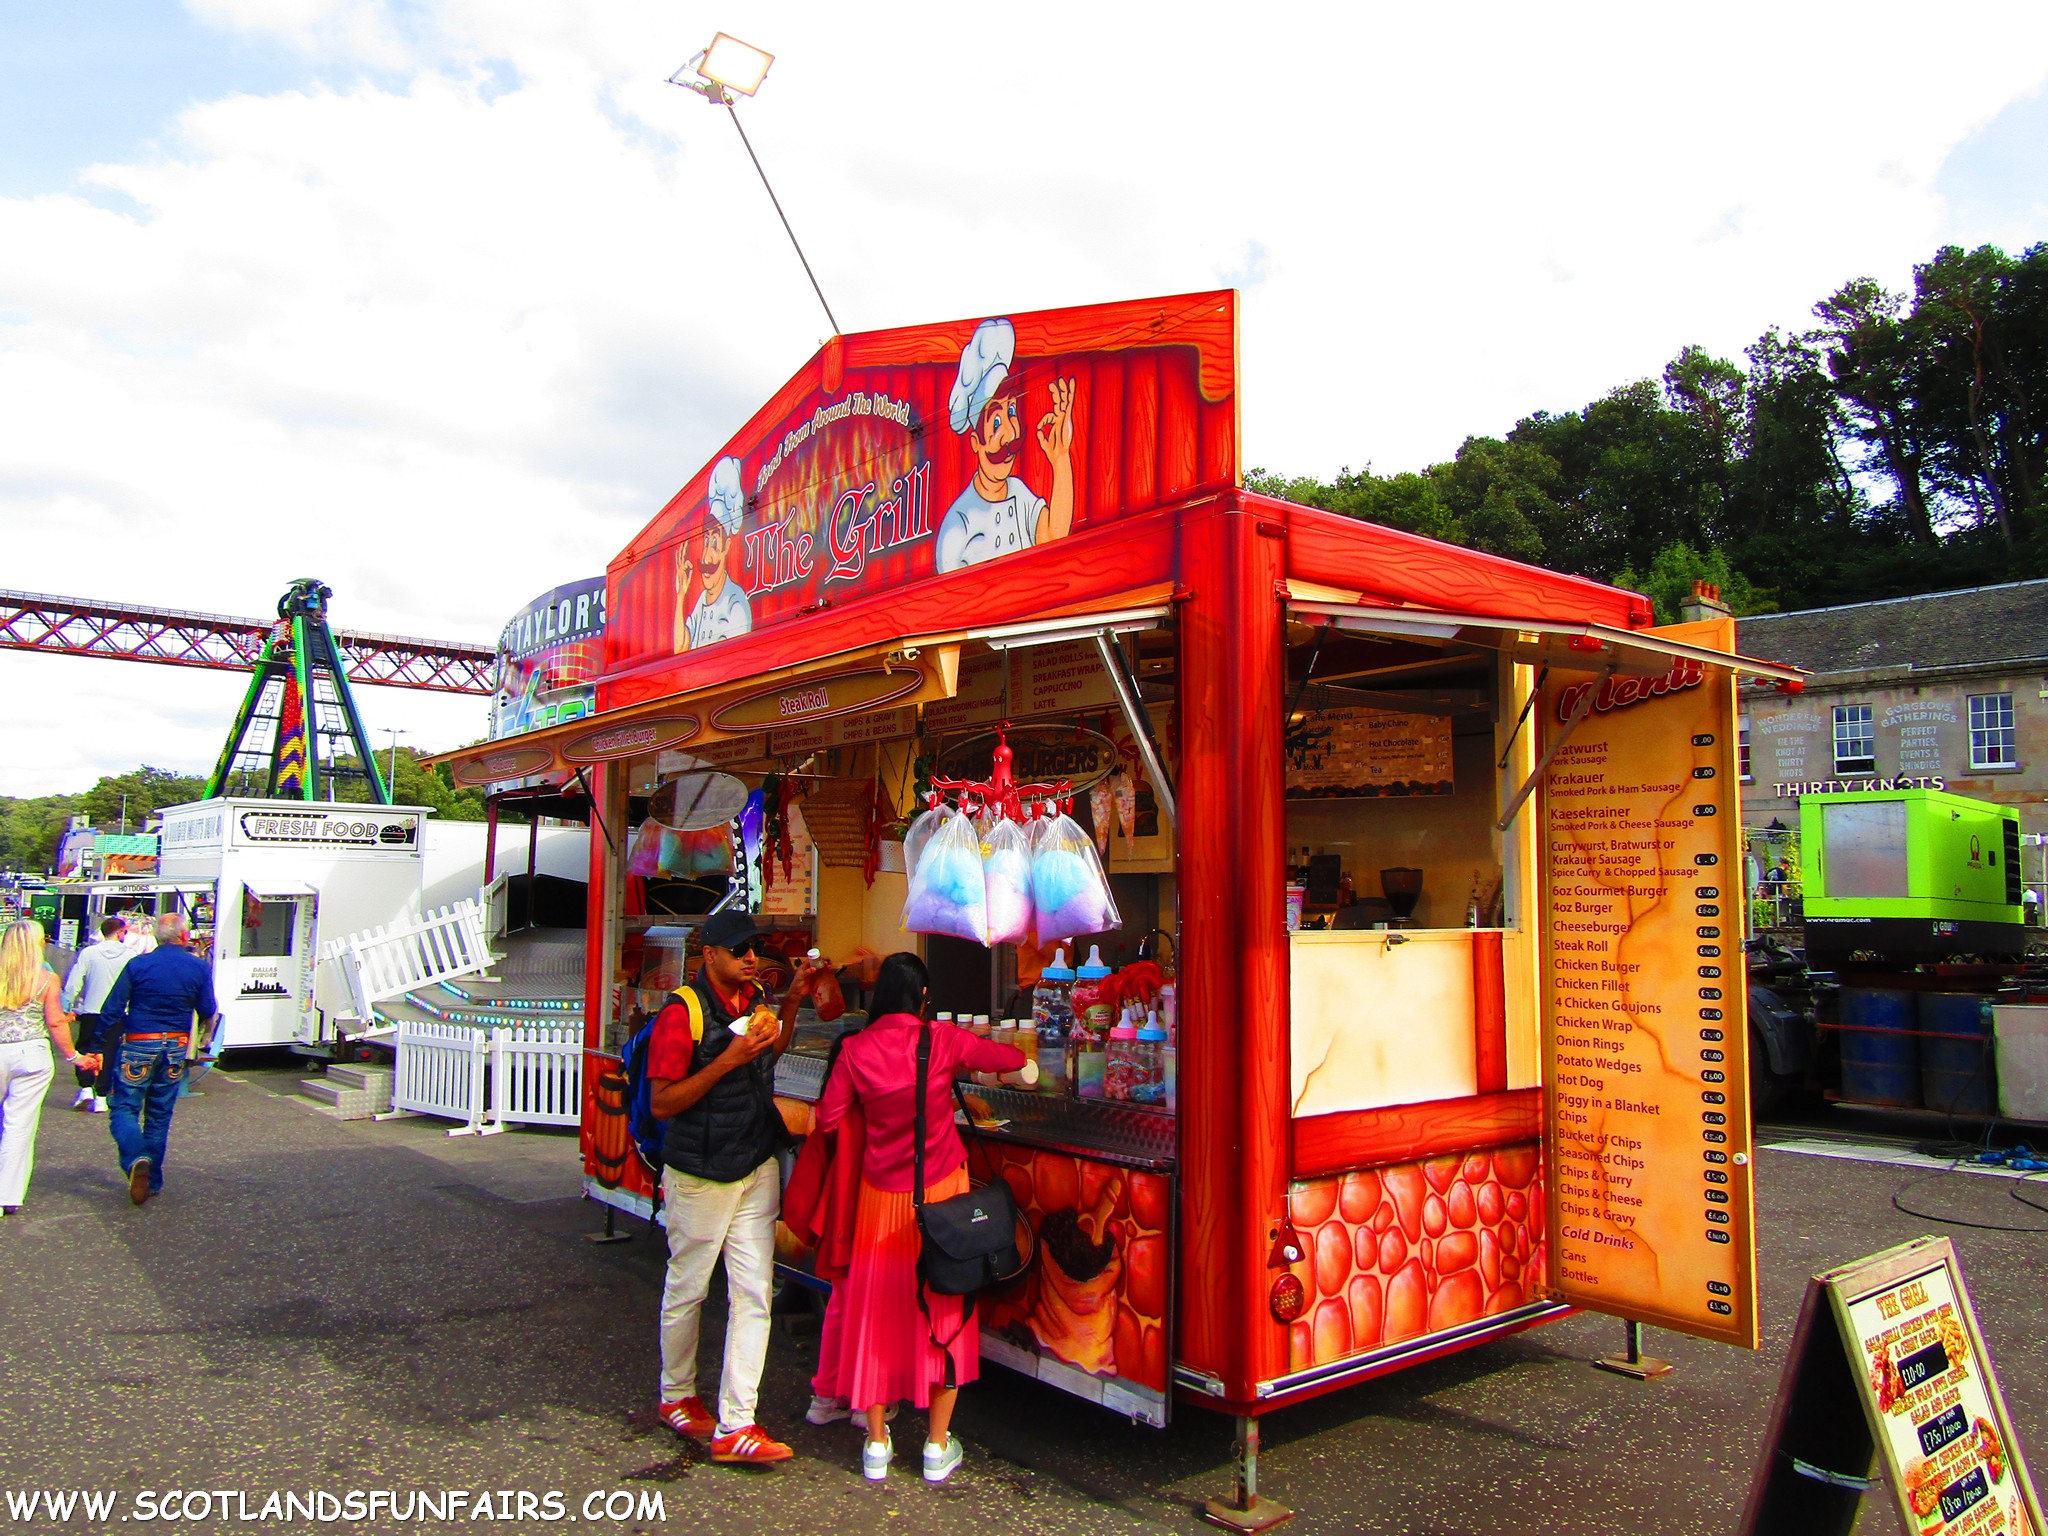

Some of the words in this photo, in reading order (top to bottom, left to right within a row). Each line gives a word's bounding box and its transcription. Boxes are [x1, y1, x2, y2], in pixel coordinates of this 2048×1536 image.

[757, 444, 782, 492] Food
[784, 422, 809, 458] From
[812, 394, 851, 435] Around
[852, 393, 871, 415] The
[874, 393, 910, 426] World
[745, 507, 813, 599] The
[825, 461, 932, 584] Grill
[1033, 657, 1057, 669] SALAD
[1060, 652, 1083, 664] ROLLS
[1033, 669, 1075, 682] BREAKFAST
[1034, 681, 1082, 696] CAPPUCCINO
[780, 693, 807, 715] Steak
[808, 687, 829, 708] Roll
[1034, 699, 1055, 709] LATTE
[1885, 702, 1951, 716] GORGEOUS
[844, 717, 863, 728] CHIPS
[866, 716, 870, 724] &
[873, 711, 896, 723] GRAVY
[1328, 713, 1352, 721] Menu
[1757, 713, 1821, 726] WONDERFUL
[1881, 713, 1958, 727] GATHERINGS
[773, 731, 791, 740] STEAK
[793, 728, 808, 737] ROLL
[844, 729, 863, 740] CHIPS
[873, 724, 896, 735] BEANS
[1761, 723, 1818, 735] WEDDINGS
[1901, 726, 1936, 736] PERFECT
[592, 734, 615, 752] Chicken
[633, 728, 656, 747] Burger
[773, 742, 792, 751] BAKED
[793, 736, 823, 749] POTATOES
[1384, 739, 1419, 747] Chocolate
[1775, 748, 1794, 757] KNOT
[1900, 749, 1931, 759] EVENTS
[1934, 749, 1939, 757] &
[1571, 755, 1607, 765] Sausage
[1900, 760, 1940, 770] SHINDIGS
[1551, 773, 1604, 785] Krakauer
[1778, 768, 1803, 777] KNOTS
[1551, 787, 1584, 797] Smoked
[1587, 786, 1607, 795] Pork
[1609, 786, 1615, 794] &
[1618, 785, 1638, 793] Ham
[1642, 783, 1680, 793] Sausage
[1773, 779, 1854, 797] THIRTY
[1863, 776, 1945, 791] KNOTS
[1551, 807, 1630, 819] Kaesekrainer
[254, 819, 317, 836] FRESH
[322, 823, 378, 837] FOOD
[1551, 822, 1585, 831] Smoked
[1589, 821, 1607, 830] Pork
[1610, 821, 1616, 829] &
[1619, 820, 1651, 828] Cheese
[1654, 819, 1694, 829] Sausage
[1552, 840, 1608, 853] Currywurst,
[1611, 840, 1661, 850] Bratwurst
[1664, 840, 1675, 849] or
[1552, 854, 1596, 865] Krakauer
[1600, 854, 1641, 866] Sausage
[1552, 869, 1575, 878] Spice
[1577, 868, 1600, 878] Curry
[1605, 868, 1611, 876] &
[1614, 867, 1655, 878] Chopped
[1659, 867, 1698, 877] Sausage
[1553, 886, 1571, 895] 6oz
[1574, 886, 1624, 895] Gourmet
[1628, 886, 1667, 898] Burger
[1553, 903, 1572, 912] 4oz
[1575, 902, 1612, 915] Burger
[1554, 921, 1631, 935] Cheeseburger
[1554, 940, 1584, 950] Steak
[1587, 940, 1608, 951] Roll
[1554, 959, 1598, 970] Chicken
[1601, 961, 1640, 974] Burger
[1555, 978, 1598, 990] Chicken
[1602, 980, 1630, 992] Fillet
[1555, 998, 1562, 1006] 4
[1565, 998, 1608, 1010] Chicken
[1612, 1000, 1661, 1015] Goujons
[1556, 1016, 1599, 1028] Chicken
[1602, 1019, 1632, 1033] Wrap
[1556, 1035, 1590, 1047] Onion
[1593, 1038, 1624, 1053] Rings
[1557, 1054, 1592, 1067] Potato
[1595, 1057, 1642, 1073] Wedges
[1558, 1073, 1576, 1085] Hot
[1580, 1075, 1603, 1091] Dog
[1558, 1093, 1588, 1108] Piggy
[1592, 1097, 1602, 1108] in
[1606, 1101, 1611, 1109] a
[1615, 1099, 1660, 1115] Blanket
[1558, 1110, 1587, 1123] Chips
[1559, 1128, 1594, 1143] Bucket
[1597, 1133, 1608, 1144] of
[1611, 1135, 1642, 1149] Chips
[1559, 1146, 1610, 1163] Seasoned
[1613, 1155, 1644, 1169] Chips
[1560, 1165, 1589, 1179] Chips
[1592, 1170, 1599, 1180] &
[1602, 1172, 1632, 1188] Curry
[1560, 1184, 1589, 1199] Chips
[1592, 1189, 1600, 1199] &
[1603, 1191, 1642, 1207] Cheese
[1561, 1202, 1590, 1217] Chips
[1593, 1207, 1600, 1218] &
[1604, 1209, 1635, 1226] Gravy
[1562, 1226, 1589, 1240] Cold
[1594, 1231, 1634, 1249] Drinks
[1562, 1249, 1586, 1263] Cans
[1562, 1267, 1599, 1284] Bottles
[1875, 1292, 1901, 1320] THE
[1900, 1281, 1928, 1311] GRILL
